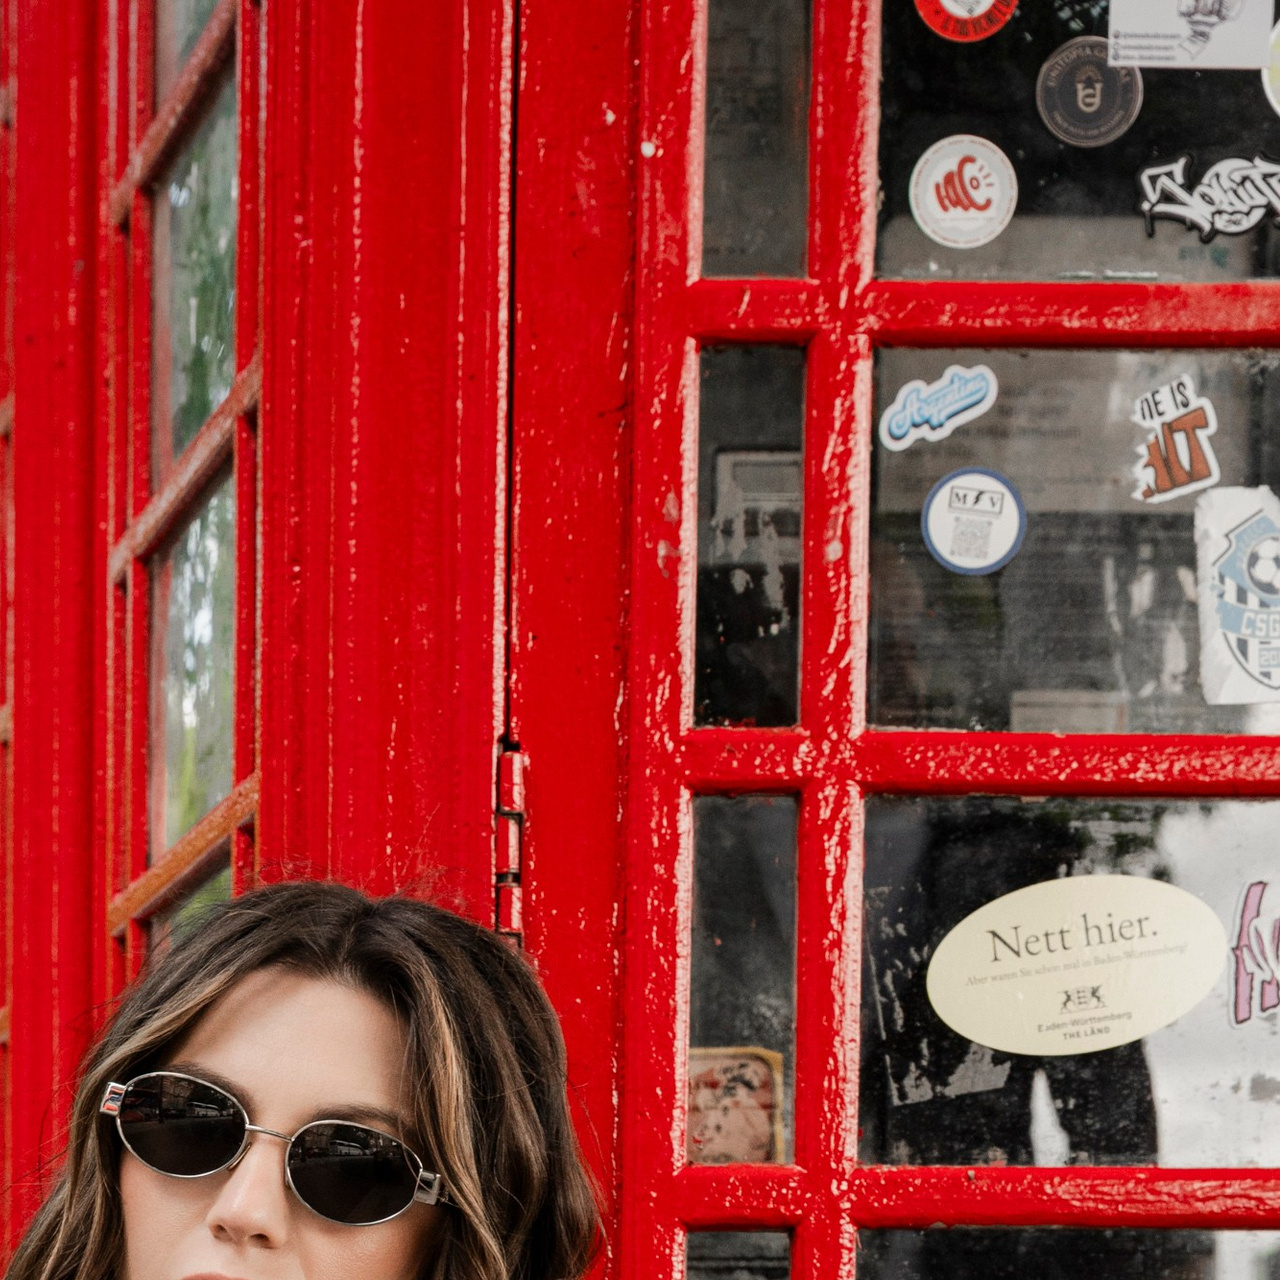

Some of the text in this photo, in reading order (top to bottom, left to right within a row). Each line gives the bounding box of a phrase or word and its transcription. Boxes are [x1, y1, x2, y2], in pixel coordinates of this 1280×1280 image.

[986, 912, 1159, 963] Nett hier.
[966, 975, 989, 987] Aber
[990, 971, 1018, 982] waren
[1019, 967, 1033, 977] Sie
[1033, 964, 1061, 976] schon
[1063, 959, 1080, 971] mal
[1063, 1030, 1081, 1041] THE
